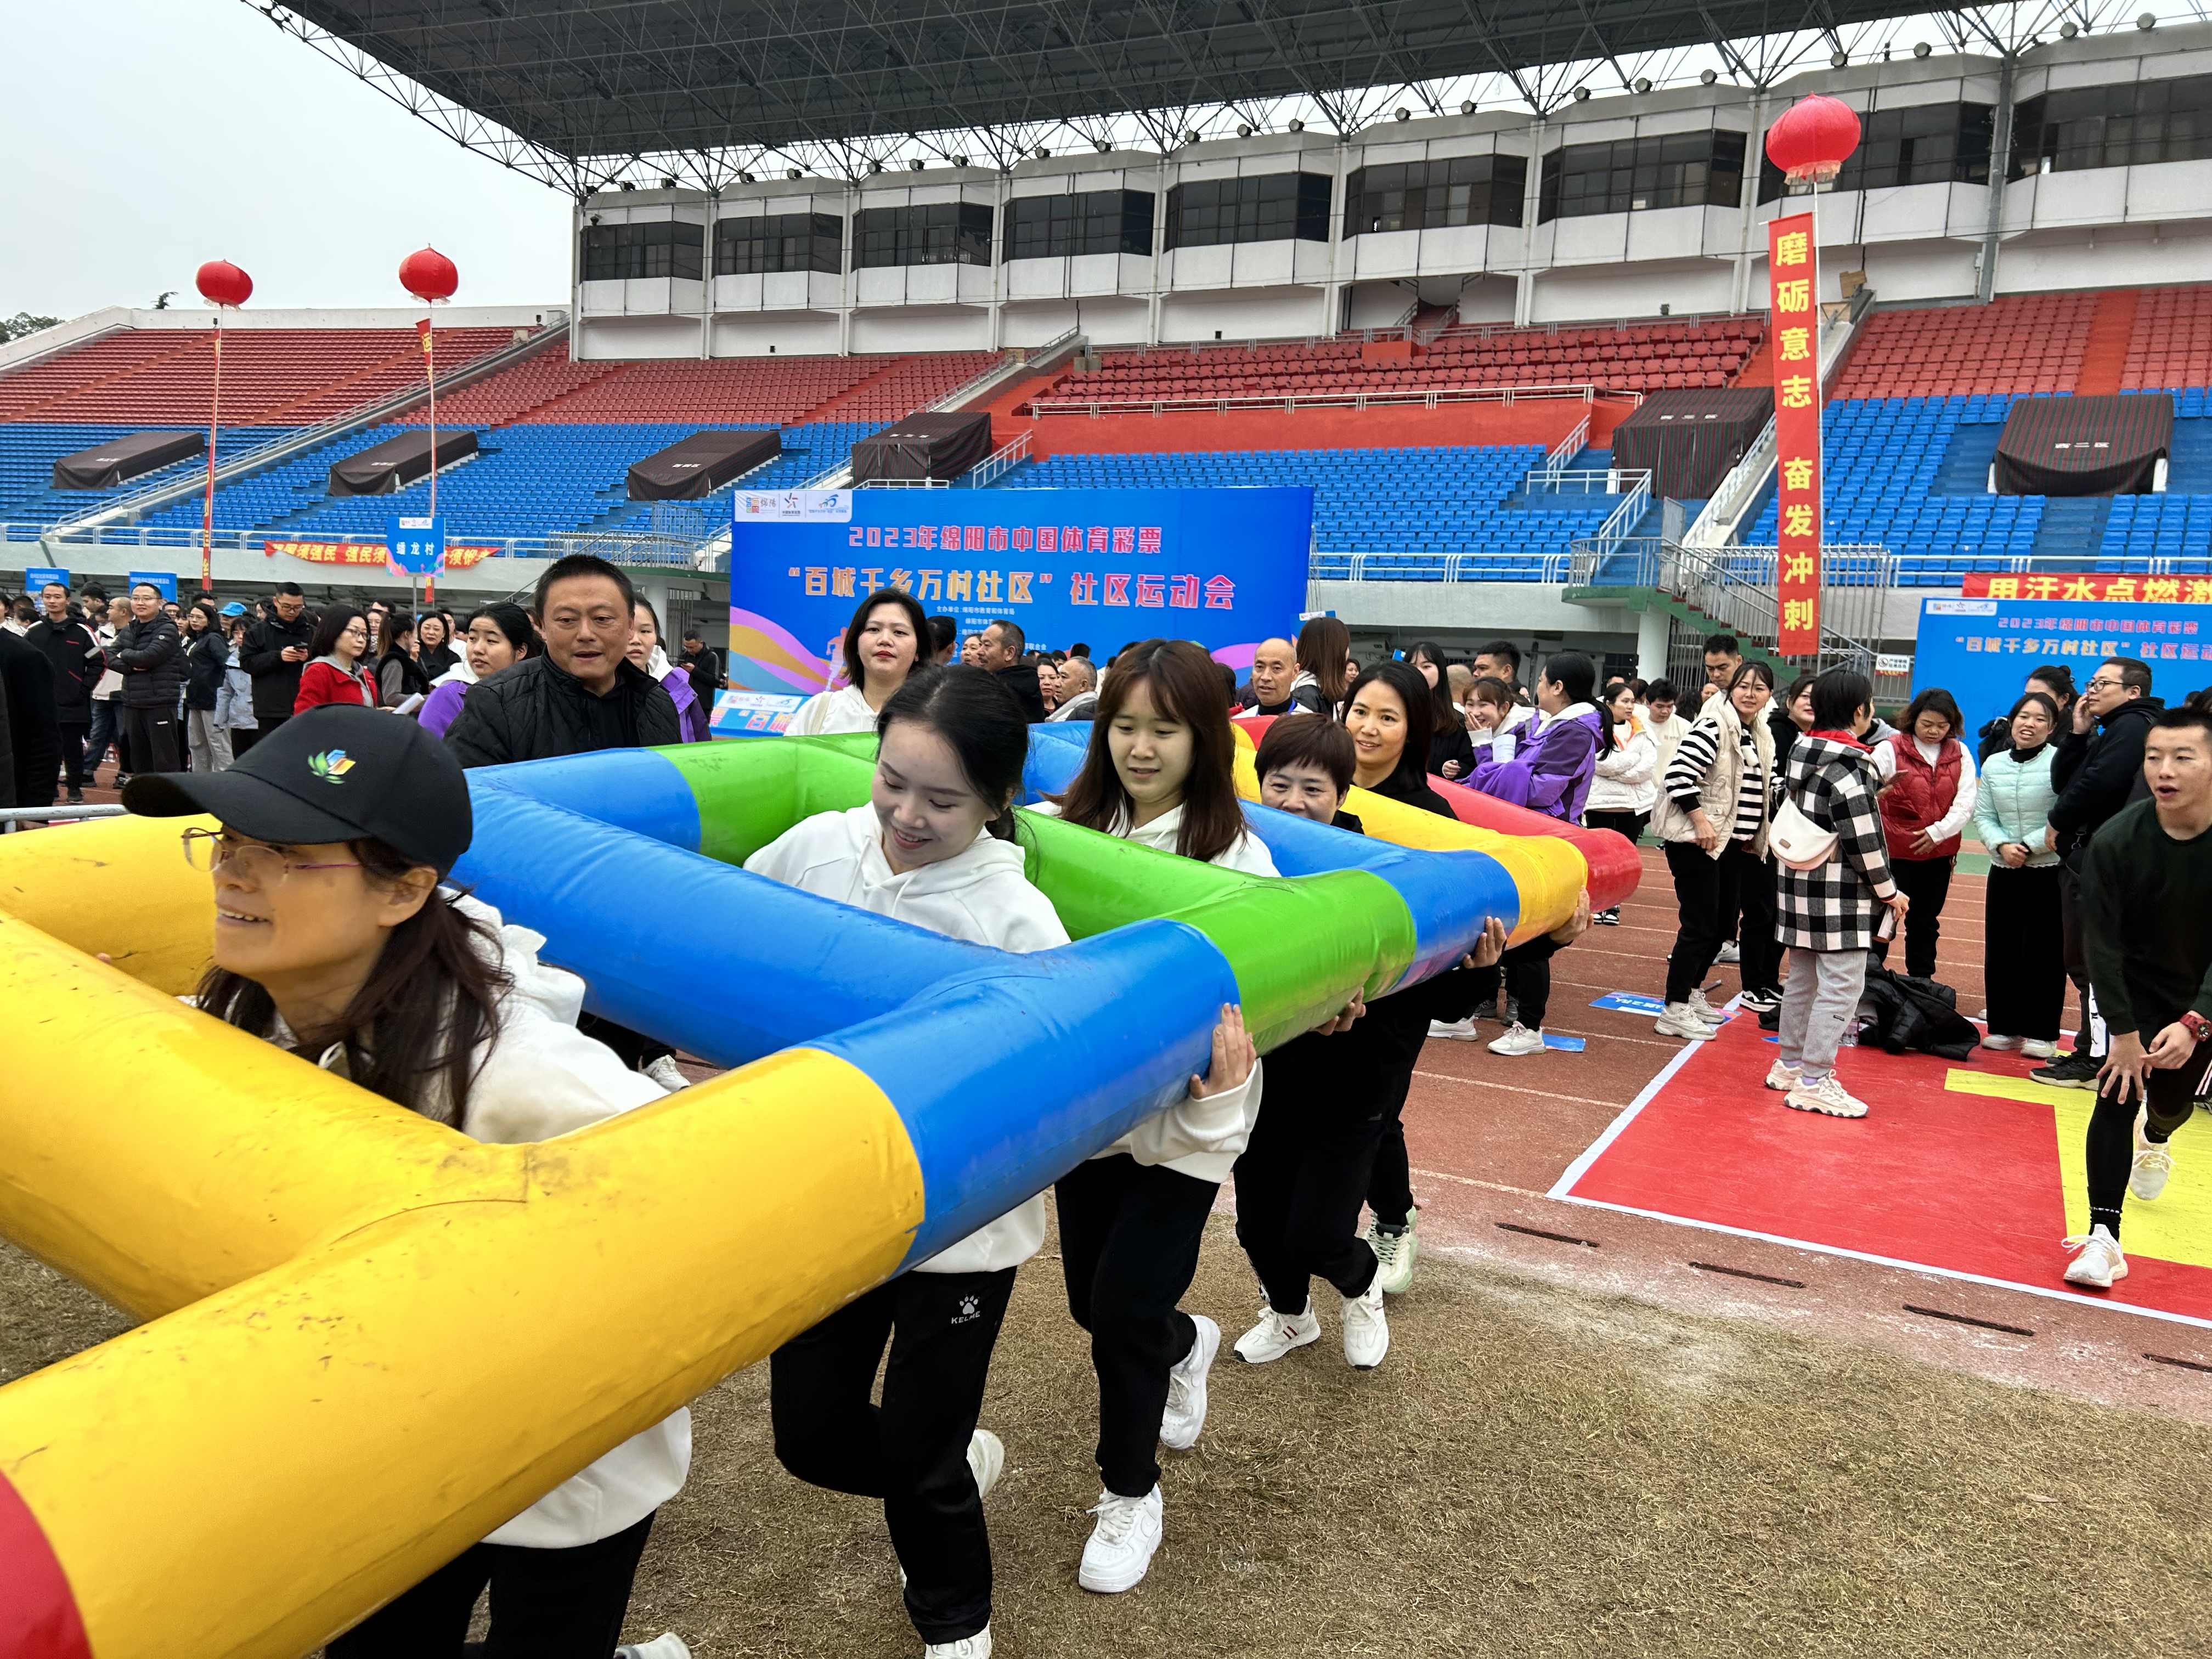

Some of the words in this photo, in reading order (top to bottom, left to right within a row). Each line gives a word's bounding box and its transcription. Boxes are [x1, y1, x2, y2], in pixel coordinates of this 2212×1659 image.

[1775, 231, 1813, 409] 磨砺意志
[396, 541, 435, 556] 蟠龙村
[849, 525, 1162, 554] 2023年绵阳市中国体育彩票
[1783, 456, 1814, 631] 奋发冲刺
[788, 567, 1053, 603] “百城千乡万村社区”
[1070, 572, 1237, 610] 社区运动会
[1998, 617, 2199, 635] 2023年绵阳市中国体育彩票
[1955, 636, 2131, 657] “百城千乡万村社区”
[951, 1311, 981, 1324] KELME
